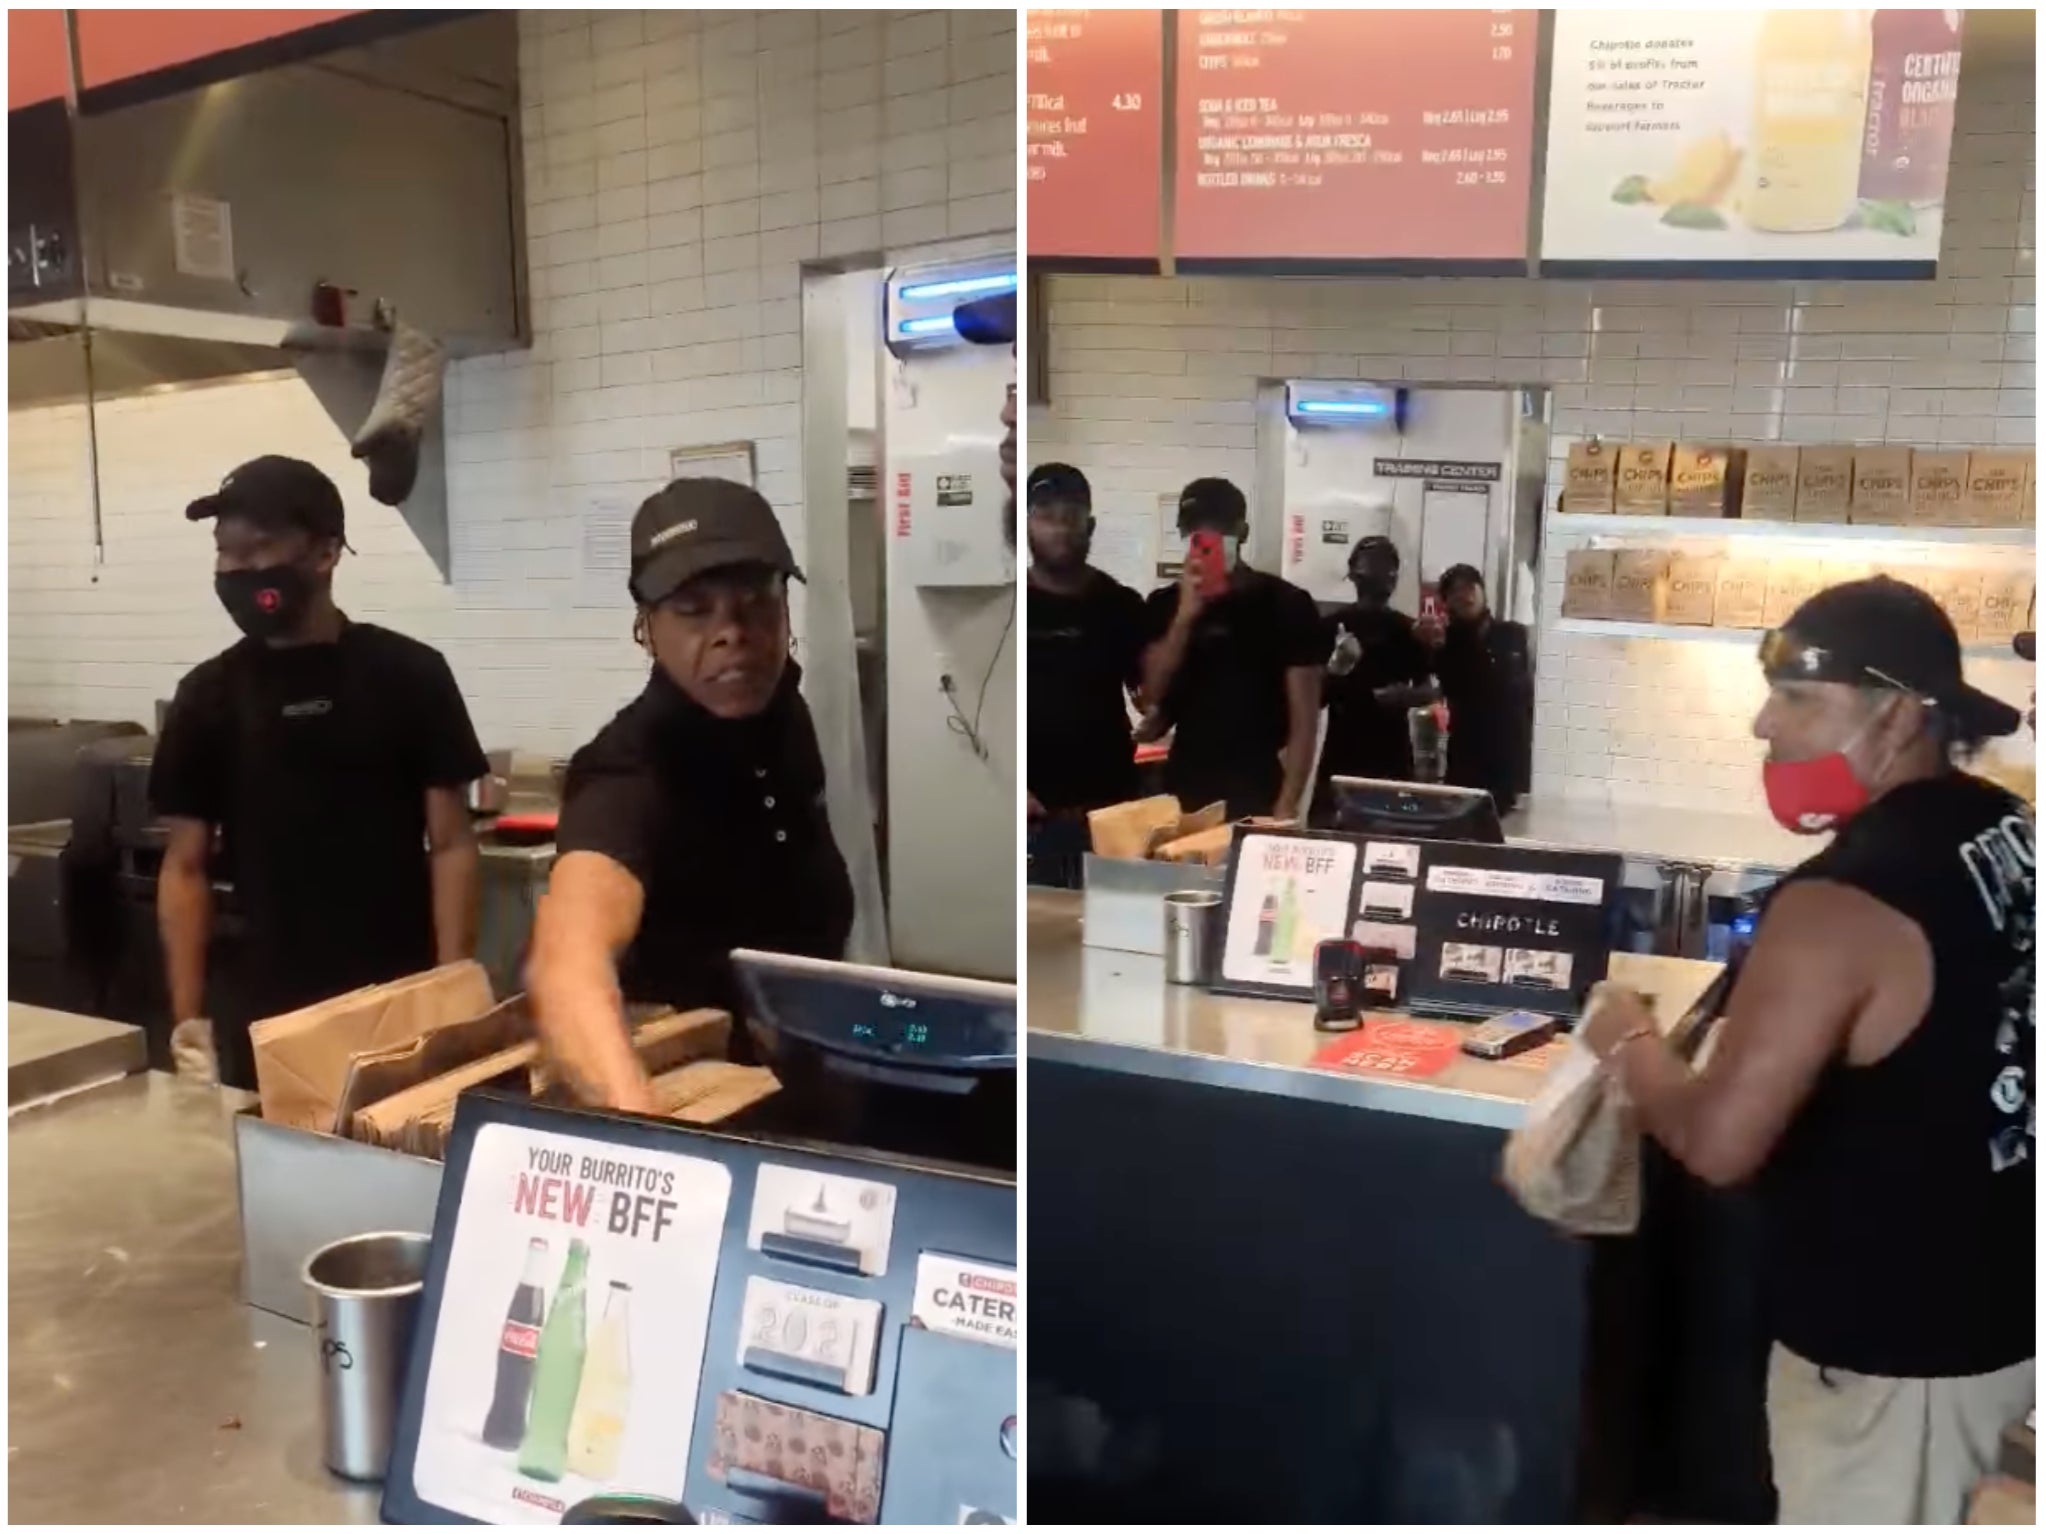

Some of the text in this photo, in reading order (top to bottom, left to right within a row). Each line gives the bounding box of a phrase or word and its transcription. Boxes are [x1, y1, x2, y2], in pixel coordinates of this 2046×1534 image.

[1589, 38, 1695, 51] Chipotle donates
[1670, 58, 1698, 70] from
[1112, 94, 1141, 110] 4.30
[1259, 98, 1278, 111] TEA
[1376, 461, 1498, 477] TRAINING CENTER
[1569, 468, 1608, 481] CHIPS
[1624, 468, 1663, 481] CHIPS
[1677, 471, 1719, 485] CHIPS
[1749, 472, 1791, 486] CHIPS
[1974, 478, 2018, 491] CHIPS
[1306, 857, 1335, 874] BFF
[1456, 912, 1560, 937] CHIPOTLE
[529, 1146, 675, 1196] YOUR BURRITO'S
[514, 1171, 678, 1243] NEW BFF
[932, 1287, 1016, 1323] CATER
[752, 1306, 860, 1369] 2021
